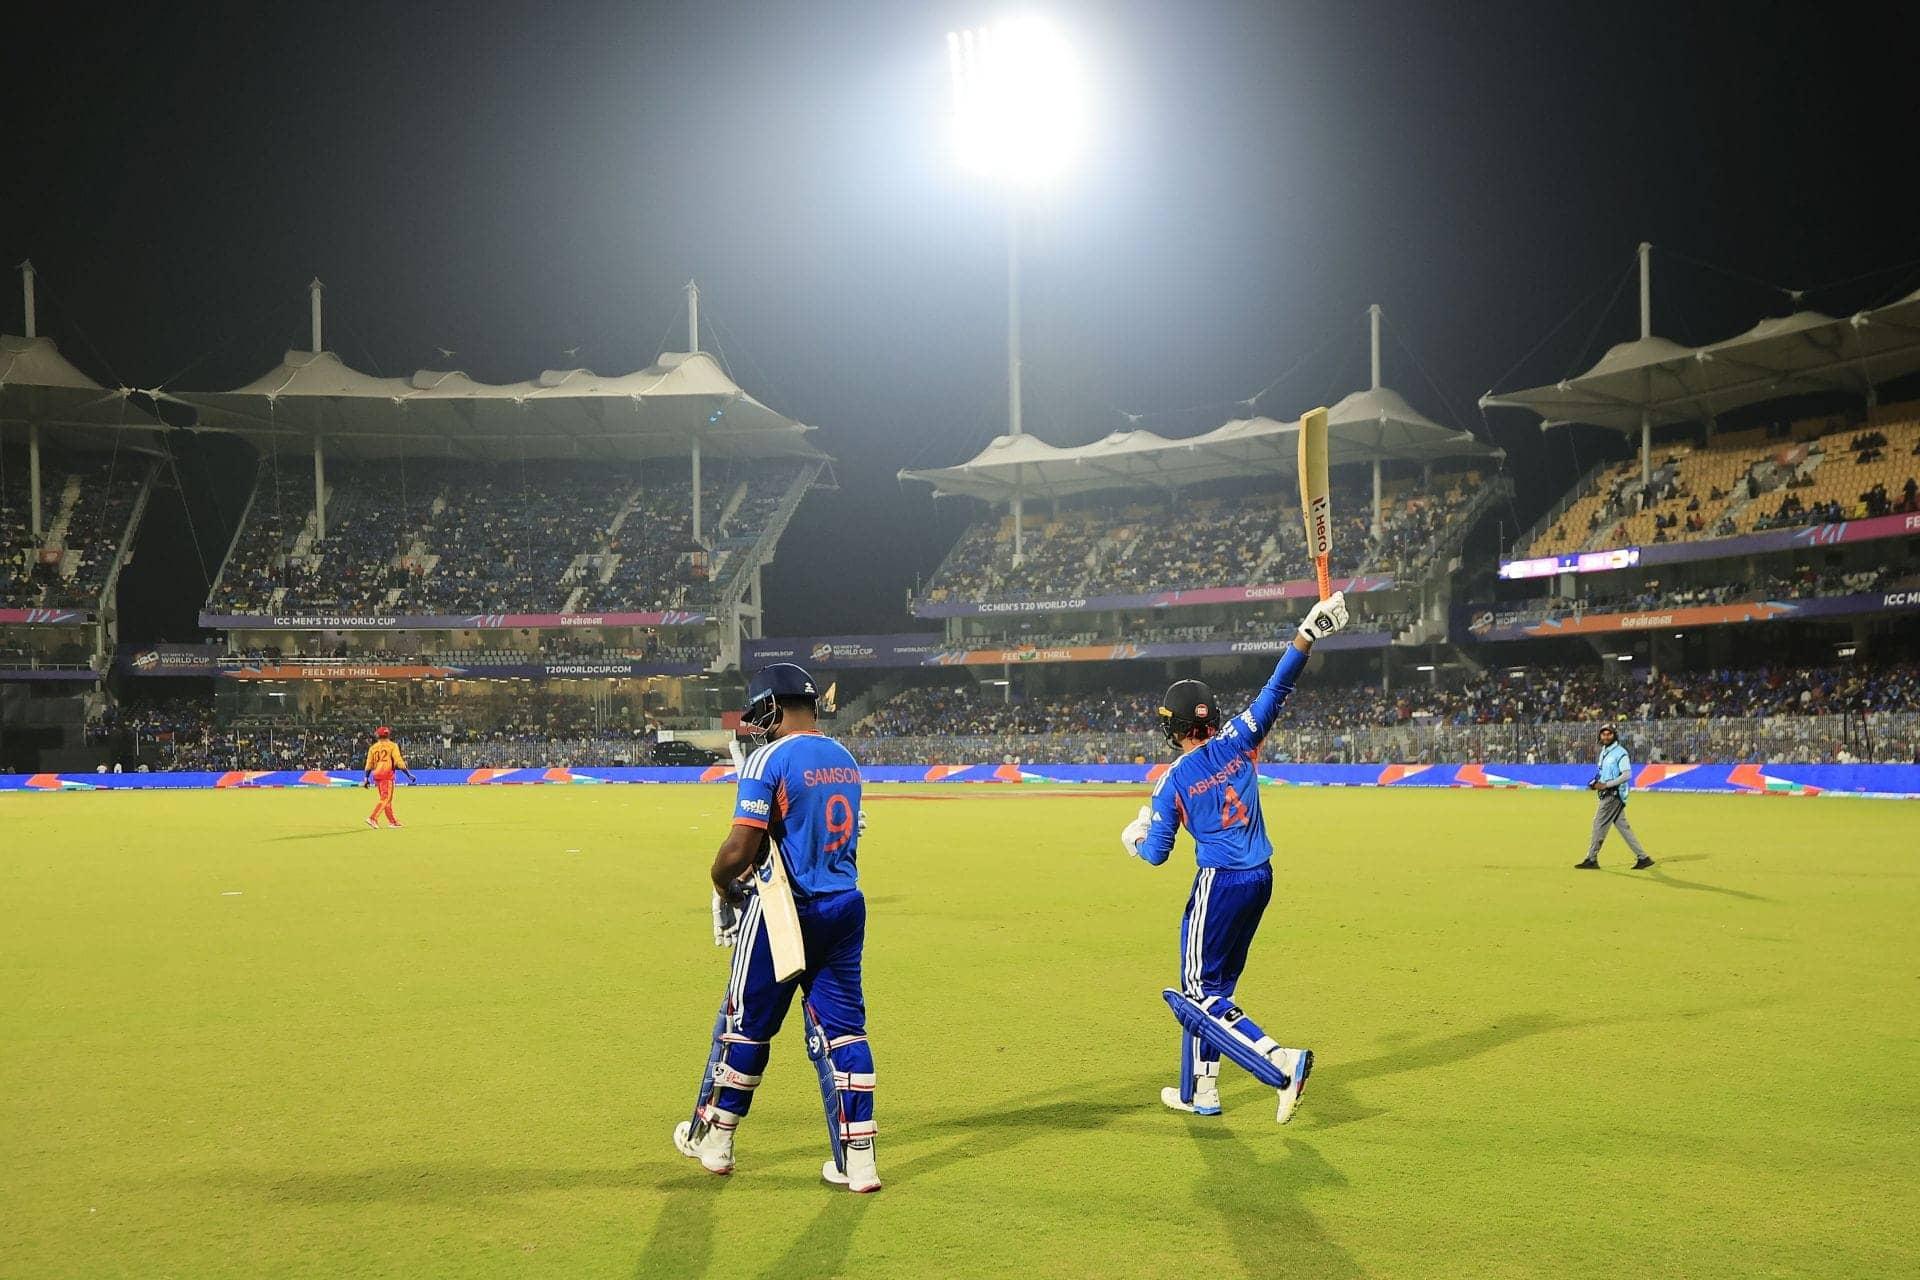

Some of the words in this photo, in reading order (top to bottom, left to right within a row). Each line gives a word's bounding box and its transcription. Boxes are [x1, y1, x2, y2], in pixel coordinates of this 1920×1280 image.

[1315, 514, 1327, 552] Hero
[1245, 587, 1285, 598] CHENNAI
[1883, 593, 1905, 606] ICC
[979, 604, 993, 612] ICC
[994, 603, 1019, 611] MEN'S
[1020, 602, 1035, 610] T20
[1036, 600, 1067, 609] WORLD
[1068, 599, 1086, 608] CUP
[274, 617, 290, 625] ICC
[292, 617, 320, 625] MEN'S
[324, 617, 340, 625] T20
[342, 617, 375, 625] WORLD
[377, 617, 396, 625] CUP
[833, 648, 858, 656] WORLD
[859, 647, 874, 655] CUP
[1002, 652, 1022, 661] FEE
[1042, 650, 1072, 658] THRILL
[161, 656, 192, 664] WORLD
[193, 656, 210, 664] CUP
[302, 668, 325, 676] FEEL
[328, 668, 345, 676] THE
[349, 668, 380, 676] THRILL
[545, 665, 632, 674] T20WORLDCUP.COM
[804, 767, 862, 787] SAMSON
[740, 799, 770, 812] apollo
[1221, 784, 1250, 830] 4
[823, 793, 853, 852] 9
